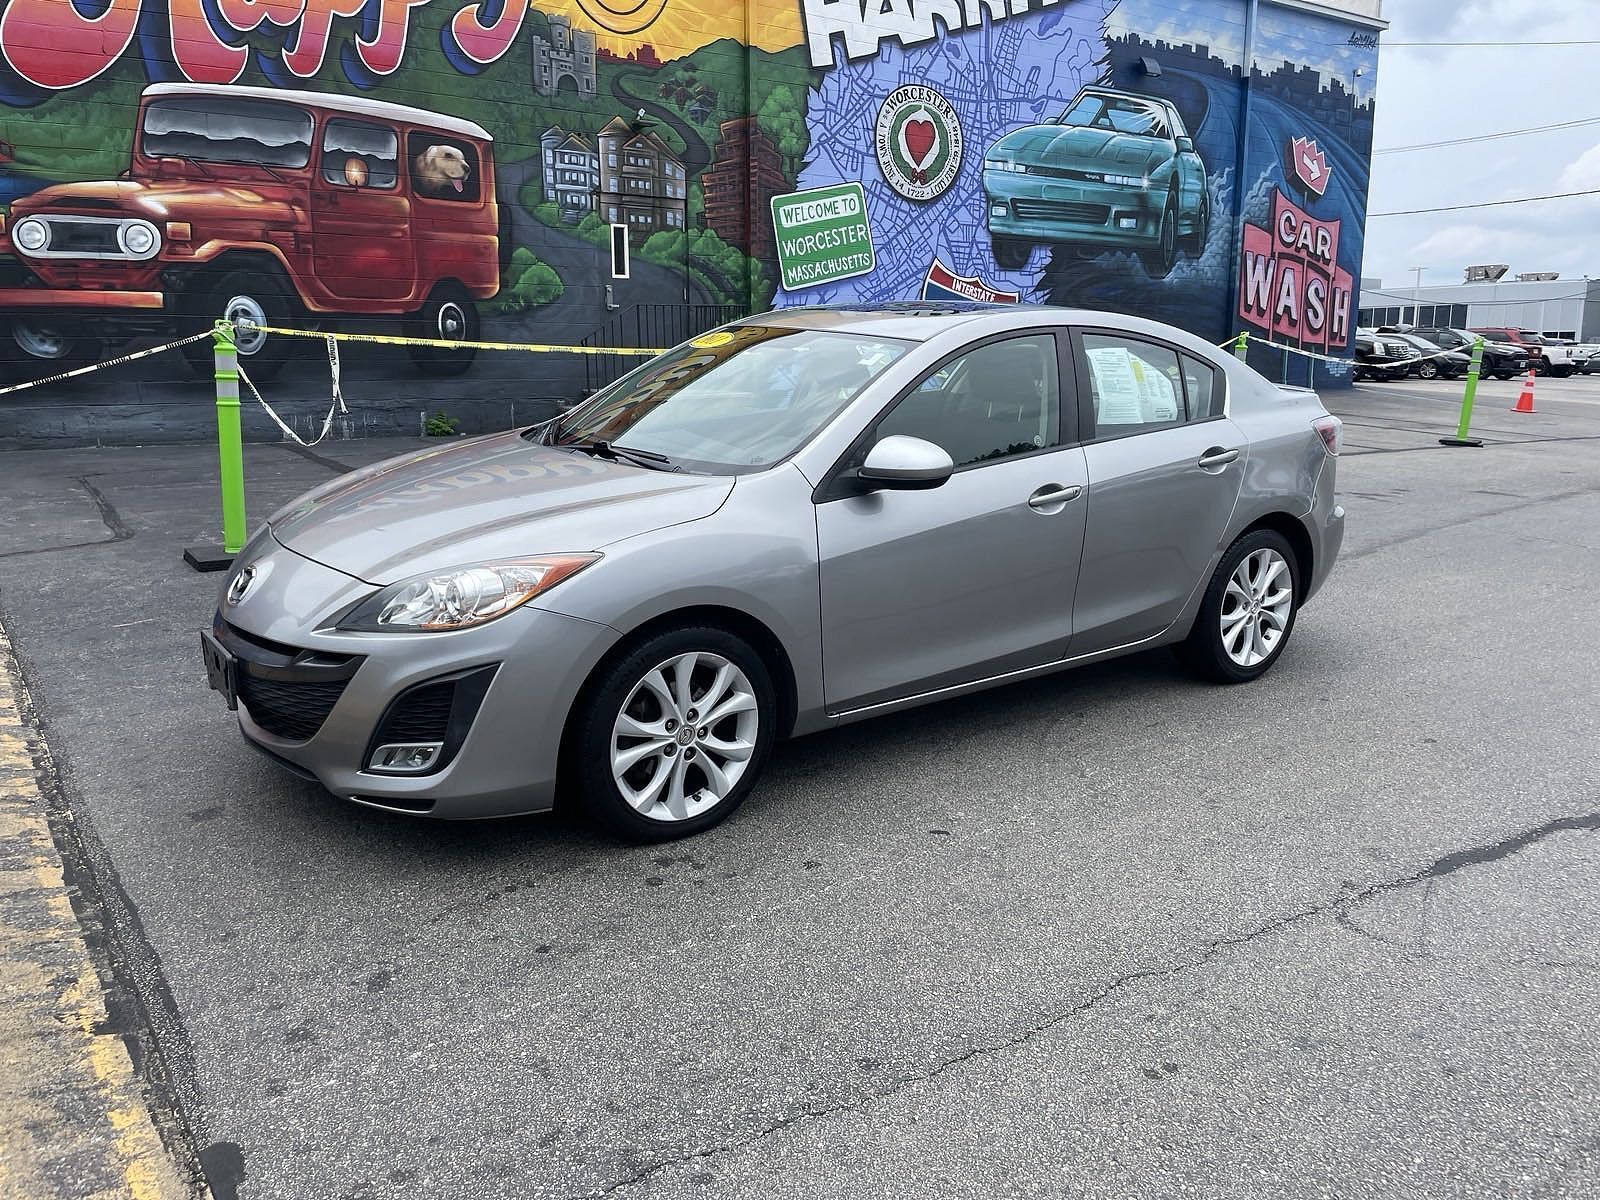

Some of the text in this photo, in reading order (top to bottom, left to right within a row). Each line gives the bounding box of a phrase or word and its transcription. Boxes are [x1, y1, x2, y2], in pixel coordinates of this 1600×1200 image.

[886, 87, 951, 119] WORCESTER
[878, 133, 888, 158] TOWN
[883, 160, 896, 181] JUNE
[907, 187, 925, 198] 1722
[935, 180, 947, 193] CITY
[782, 198, 857, 224] WELCOME TO
[782, 224, 868, 257] WORCESTER
[1279, 209, 1332, 264] CAR
[787, 253, 871, 283] MASSACHUSETTS
[1244, 250, 1350, 342] WASH
